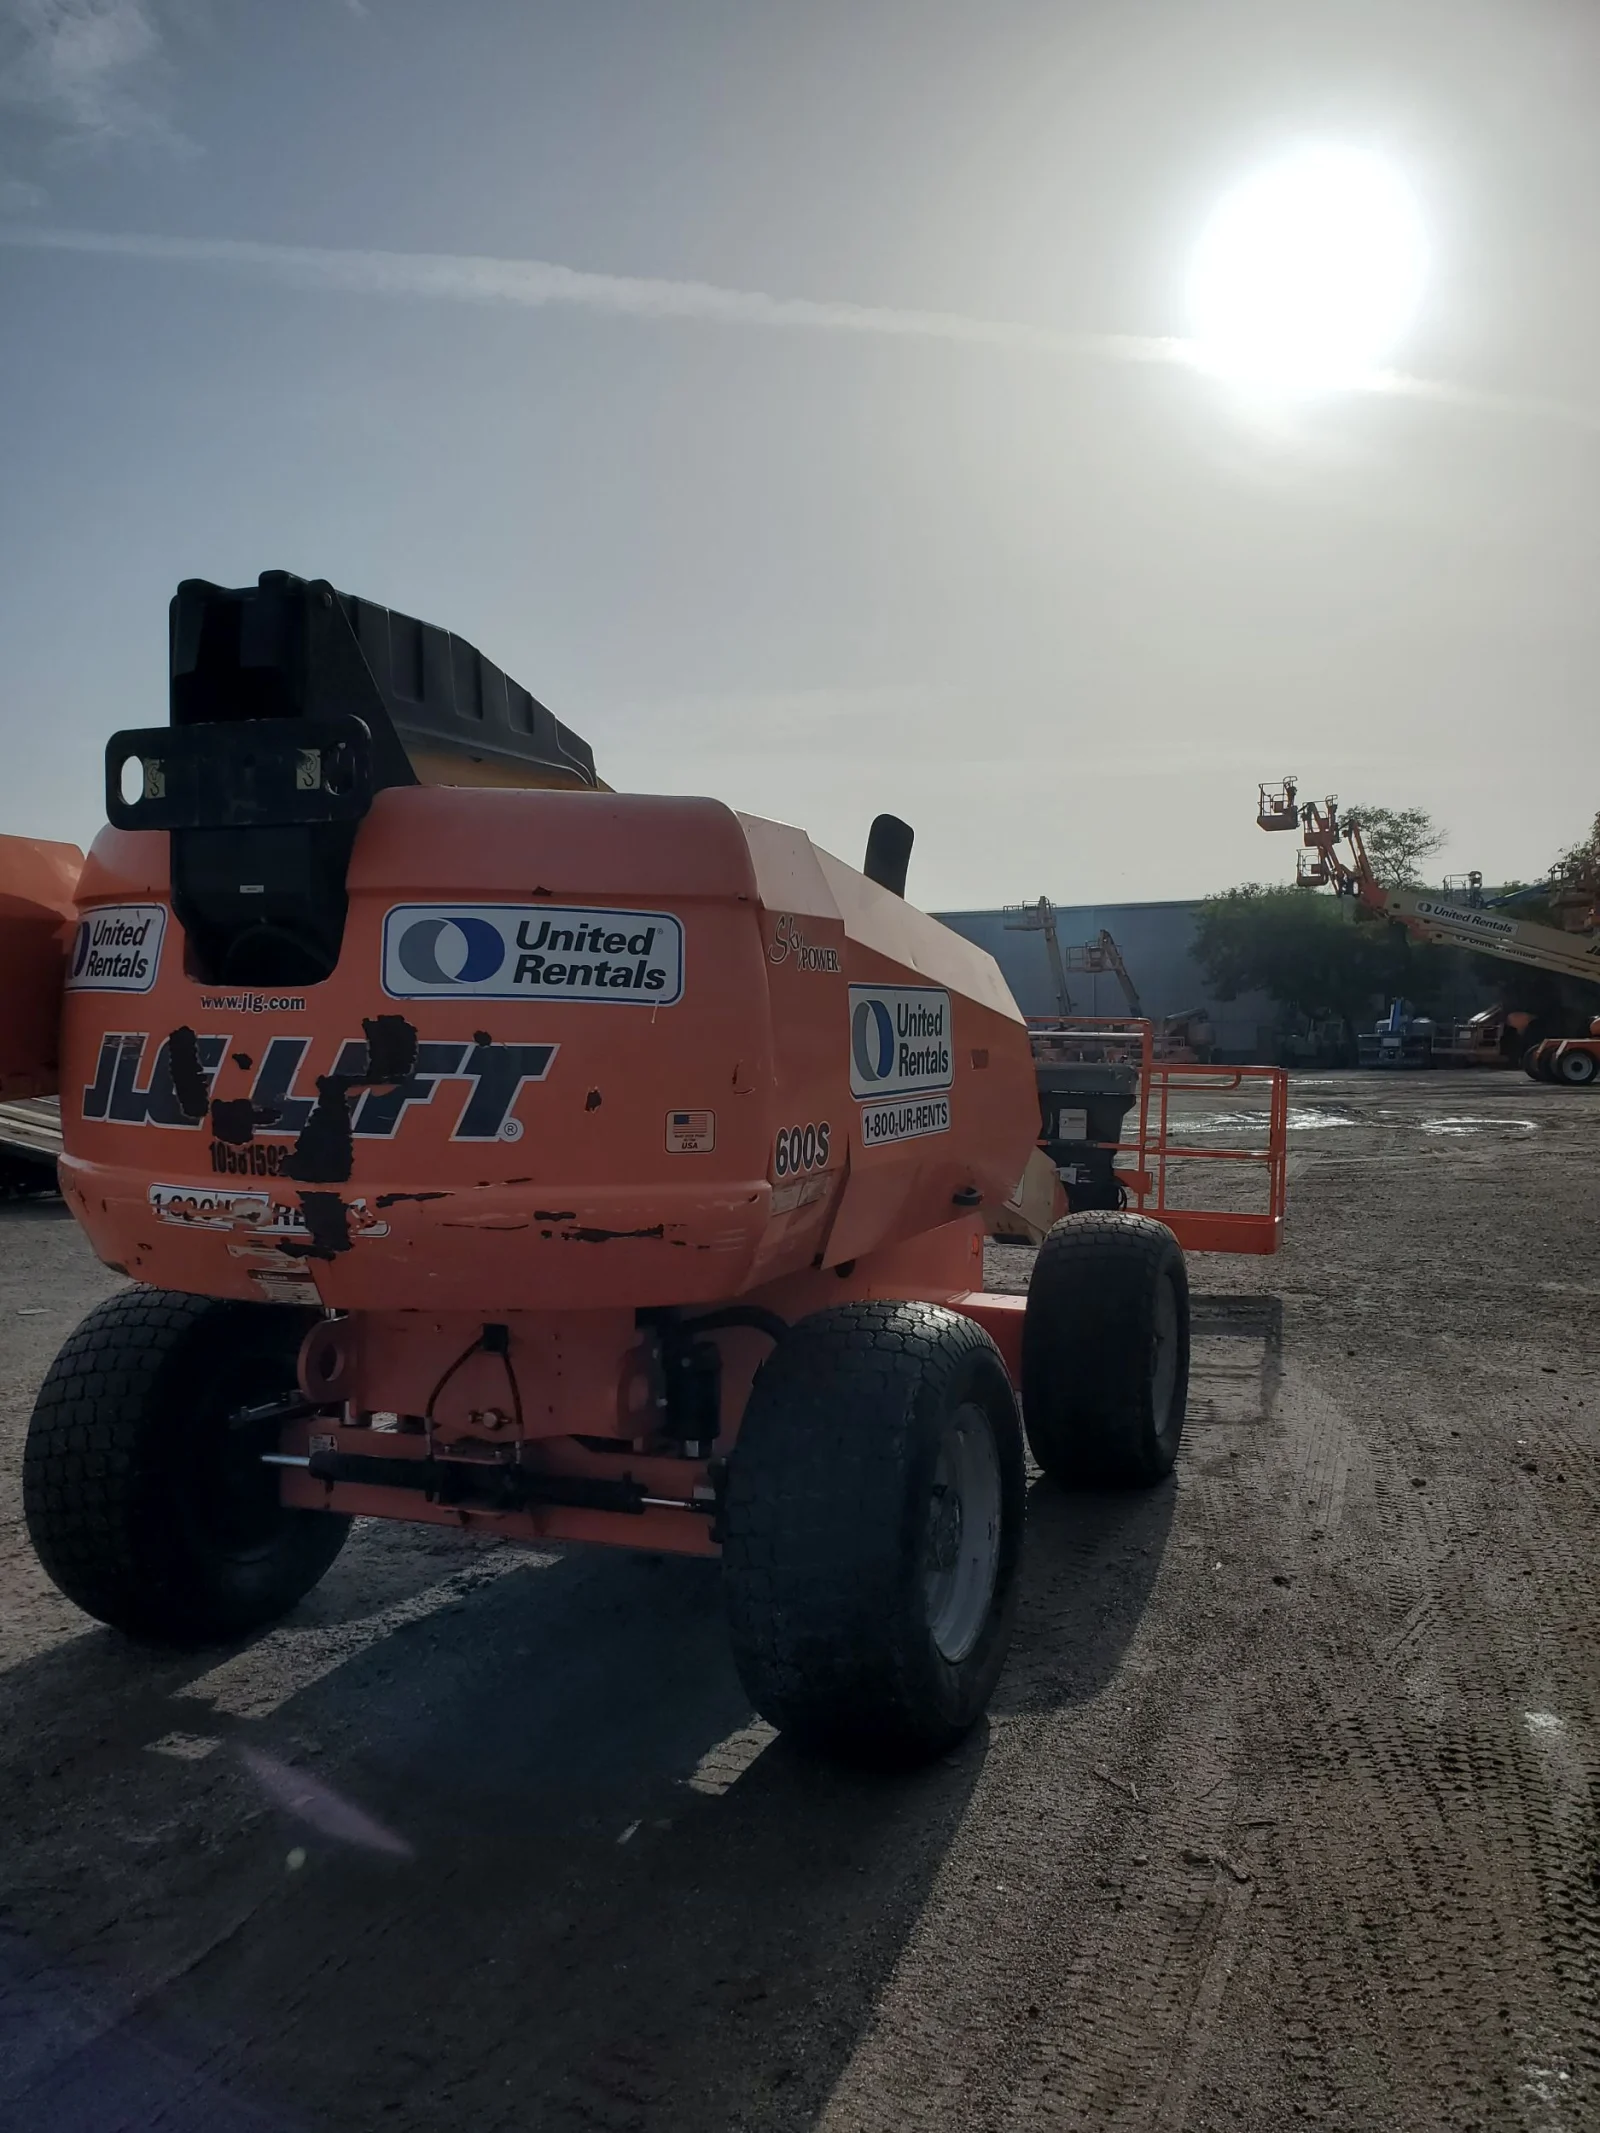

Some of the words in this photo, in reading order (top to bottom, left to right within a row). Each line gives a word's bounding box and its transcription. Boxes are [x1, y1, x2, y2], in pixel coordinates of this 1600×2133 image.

[92, 918, 152, 947] United
[1434, 906, 1471, 922] United
[1471, 916, 1513, 933] Rentals
[516, 920, 656, 956] United
[86, 950, 149, 979] Rentals
[513, 954, 667, 990] Rentals
[800, 946, 839, 971] POWER
[200, 993, 306, 1012] www.jlg.com
[897, 1003, 943, 1038] United
[899, 1041, 949, 1077] Rentals
[864, 1101, 948, 1139] 1-800-UR-RENTS
[681, 1142, 698, 1150] USA
[775, 1121, 831, 1177] 600S
